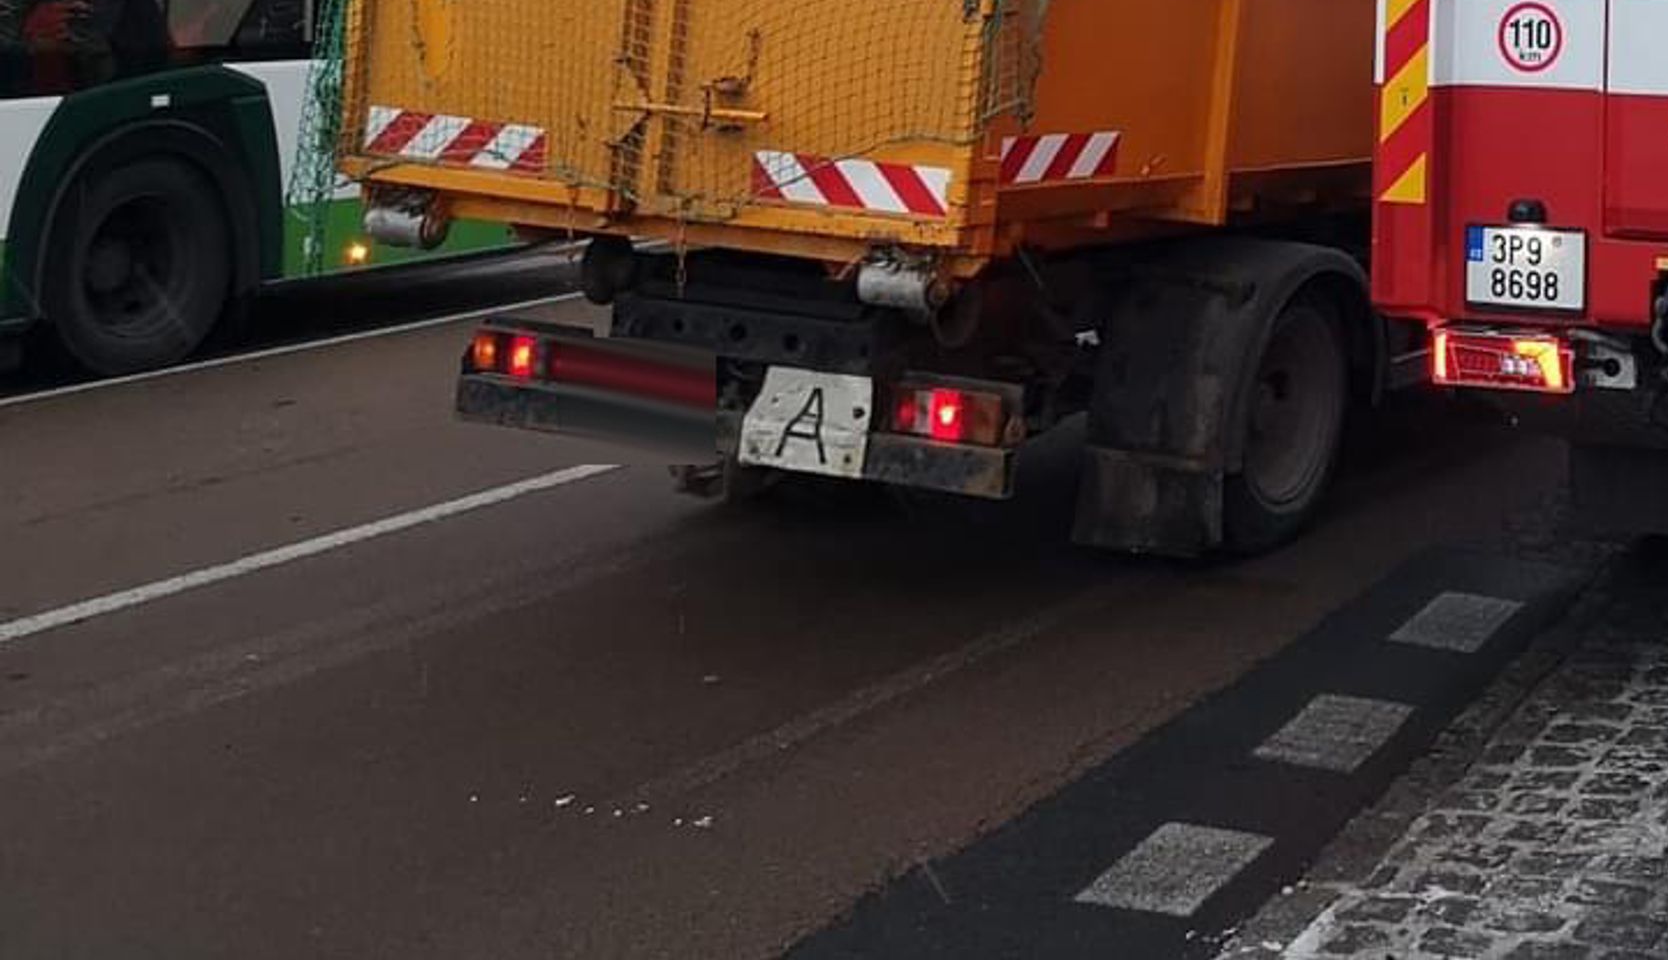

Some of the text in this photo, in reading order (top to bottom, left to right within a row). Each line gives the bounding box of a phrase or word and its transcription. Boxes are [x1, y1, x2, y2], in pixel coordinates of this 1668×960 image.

[1509, 18, 1551, 49] 110
[1491, 233, 1543, 266] 3P9
[1490, 268, 1559, 302] 8698
[774, 387, 827, 466] A
